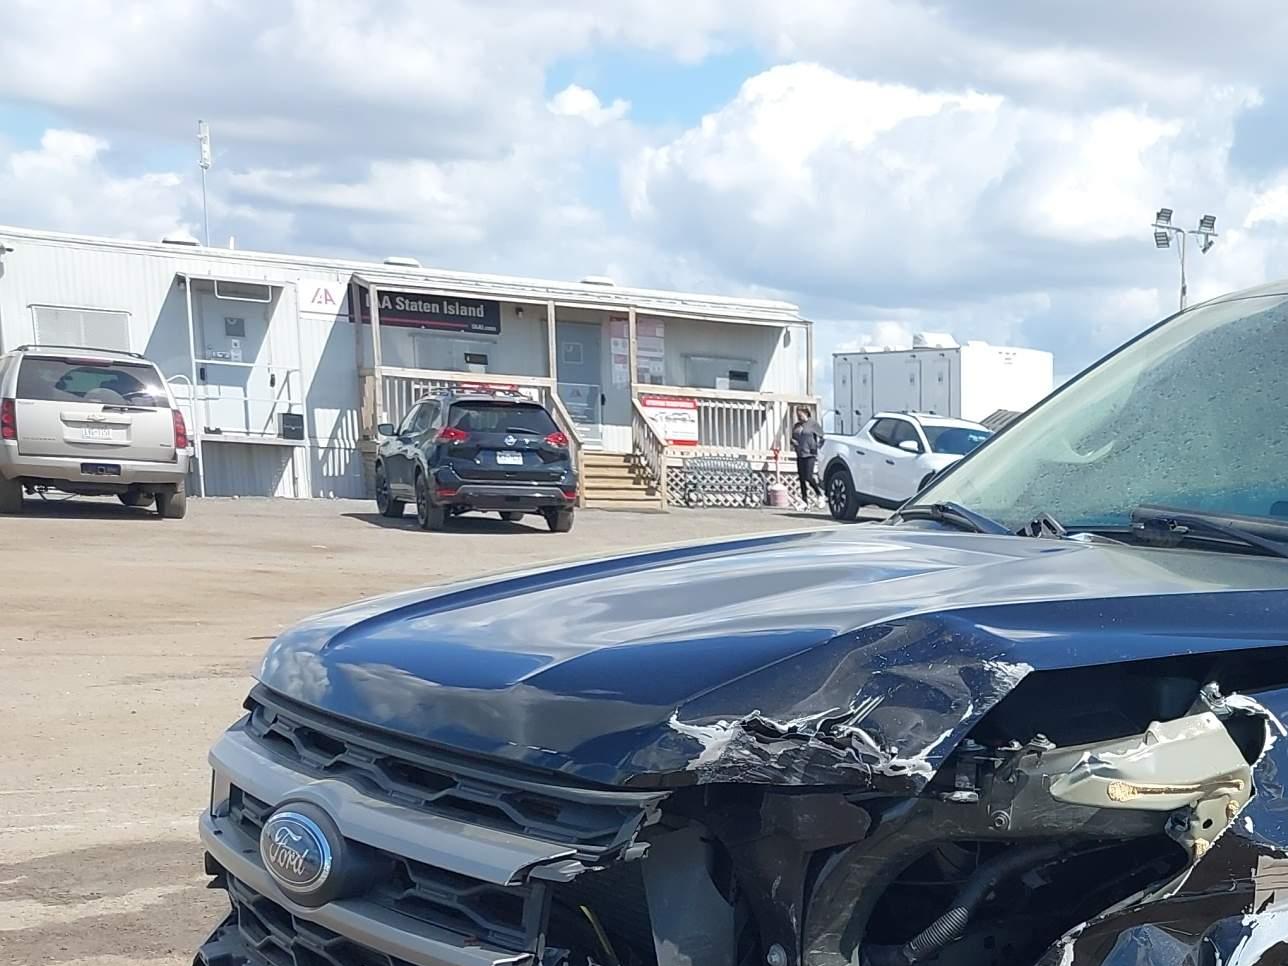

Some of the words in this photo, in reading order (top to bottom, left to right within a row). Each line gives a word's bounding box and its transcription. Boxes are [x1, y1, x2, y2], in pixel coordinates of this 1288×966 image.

[396, 297, 439, 313] Staten
[443, 302, 484, 318] Island
[268, 826, 309, 877] Ford
